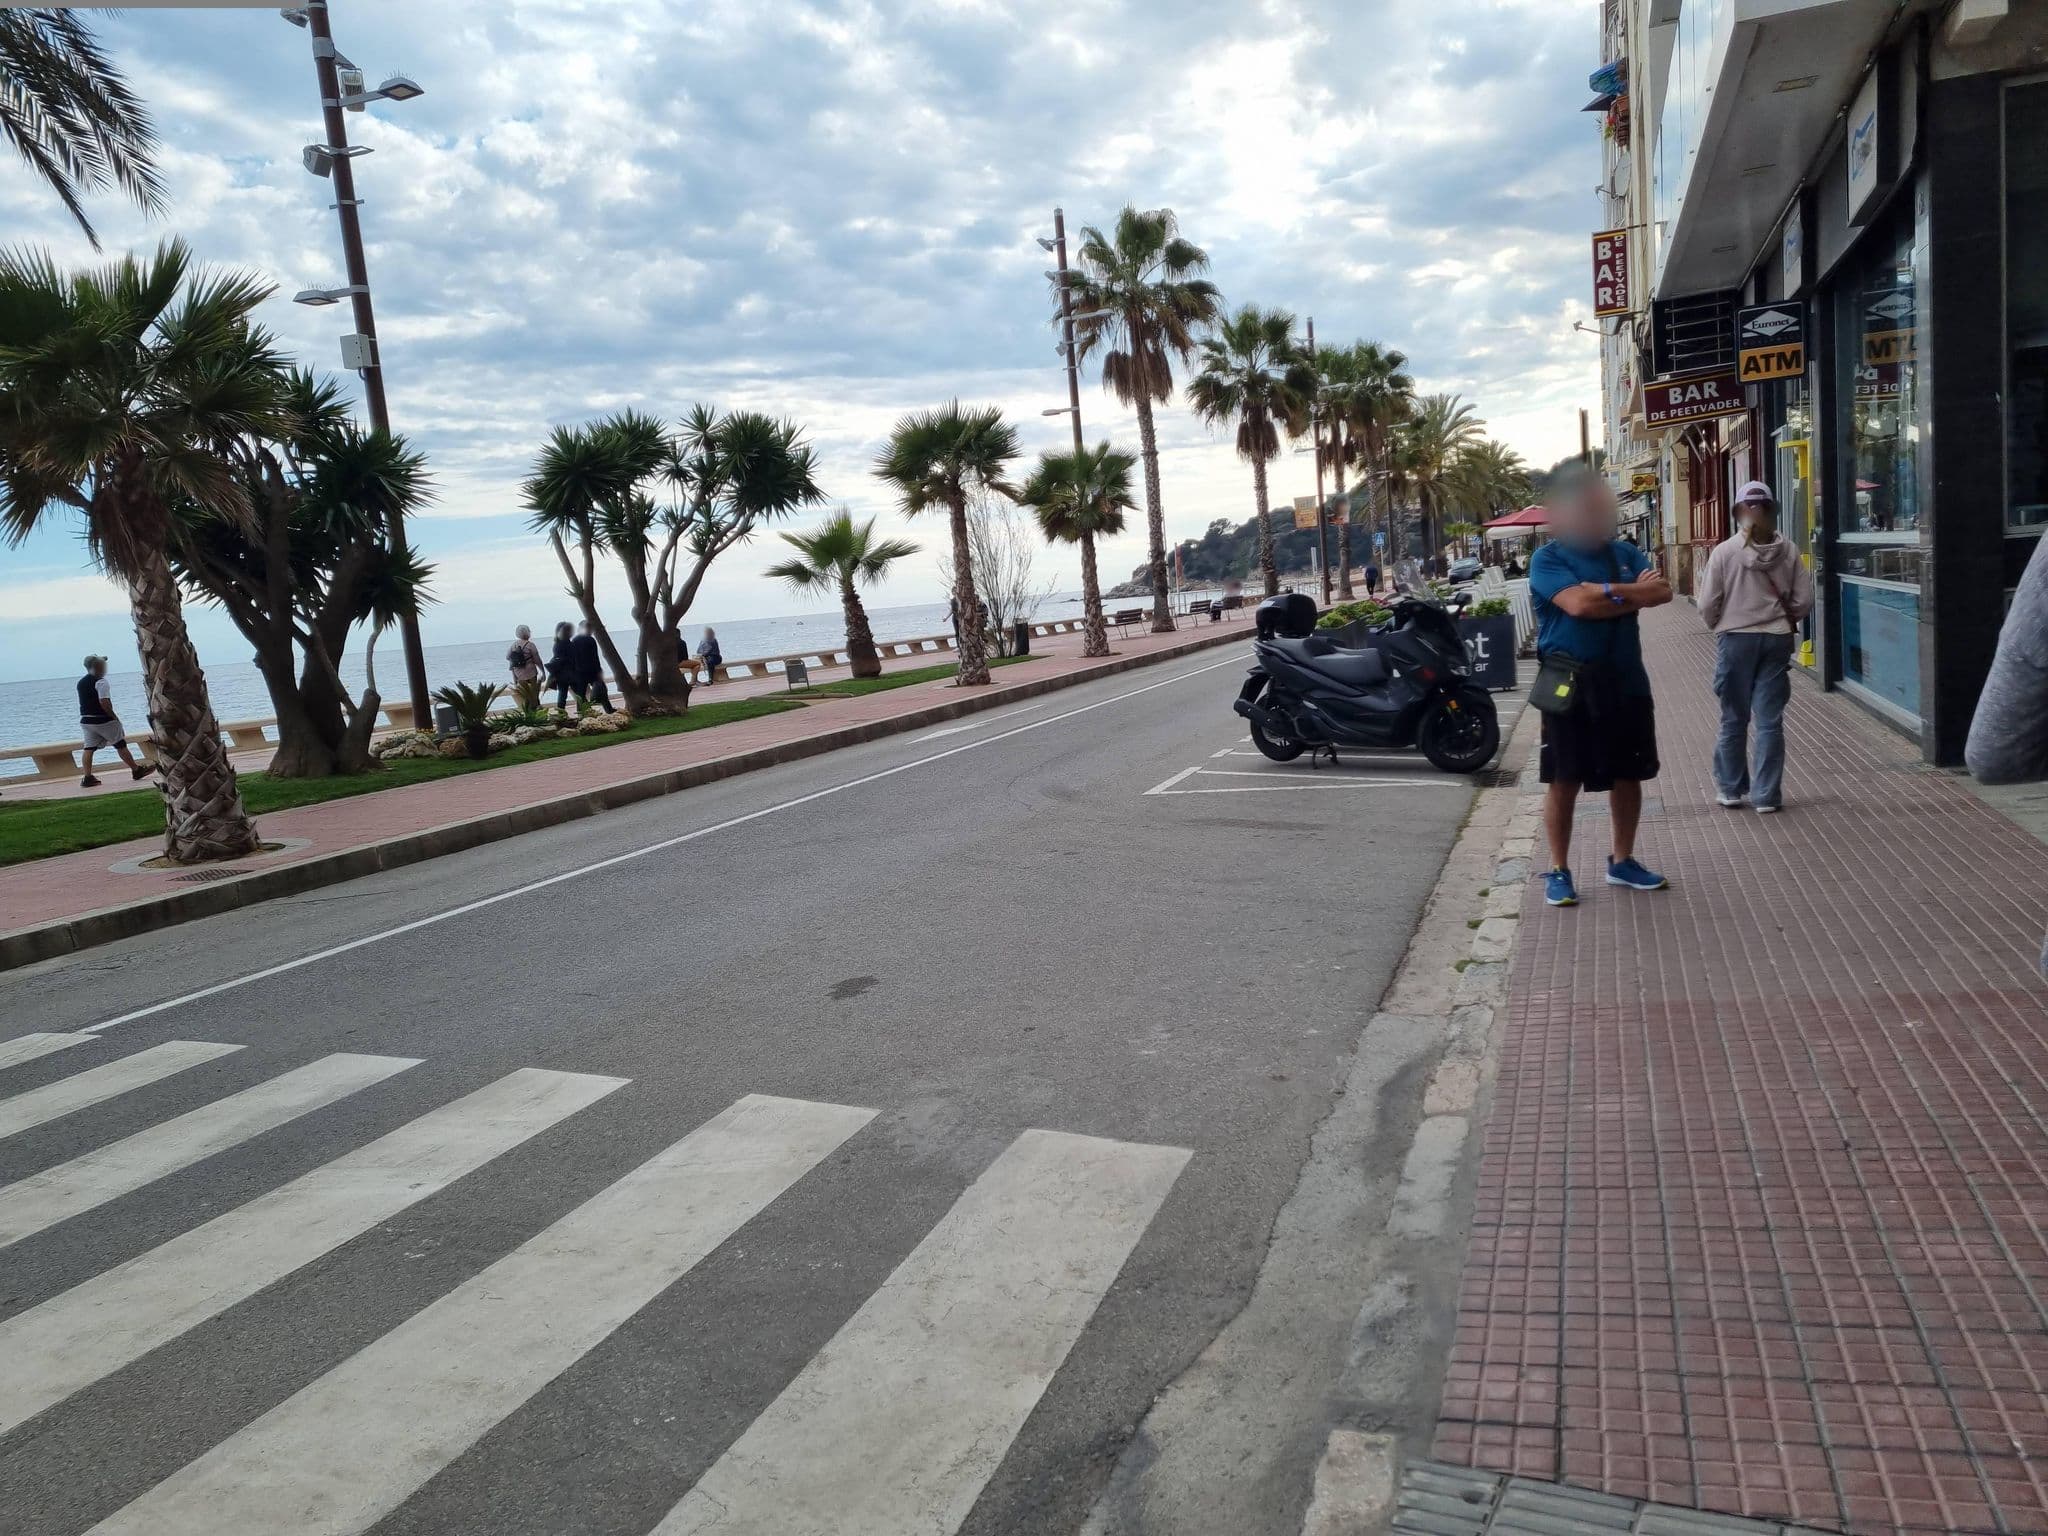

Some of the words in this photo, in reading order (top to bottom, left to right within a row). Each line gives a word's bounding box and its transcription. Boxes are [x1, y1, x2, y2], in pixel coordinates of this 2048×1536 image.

[1614, 234, 1625, 247] DE
[1597, 241, 1614, 306] BAR
[1615, 252, 1626, 307] PEETVADER
[1743, 349, 1801, 376] ATM
[1668, 381, 1719, 405] BAR
[1650, 410, 1669, 421] DE
[1670, 398, 1741, 418] PEETVADER
[1474, 662, 1489, 672] ar
